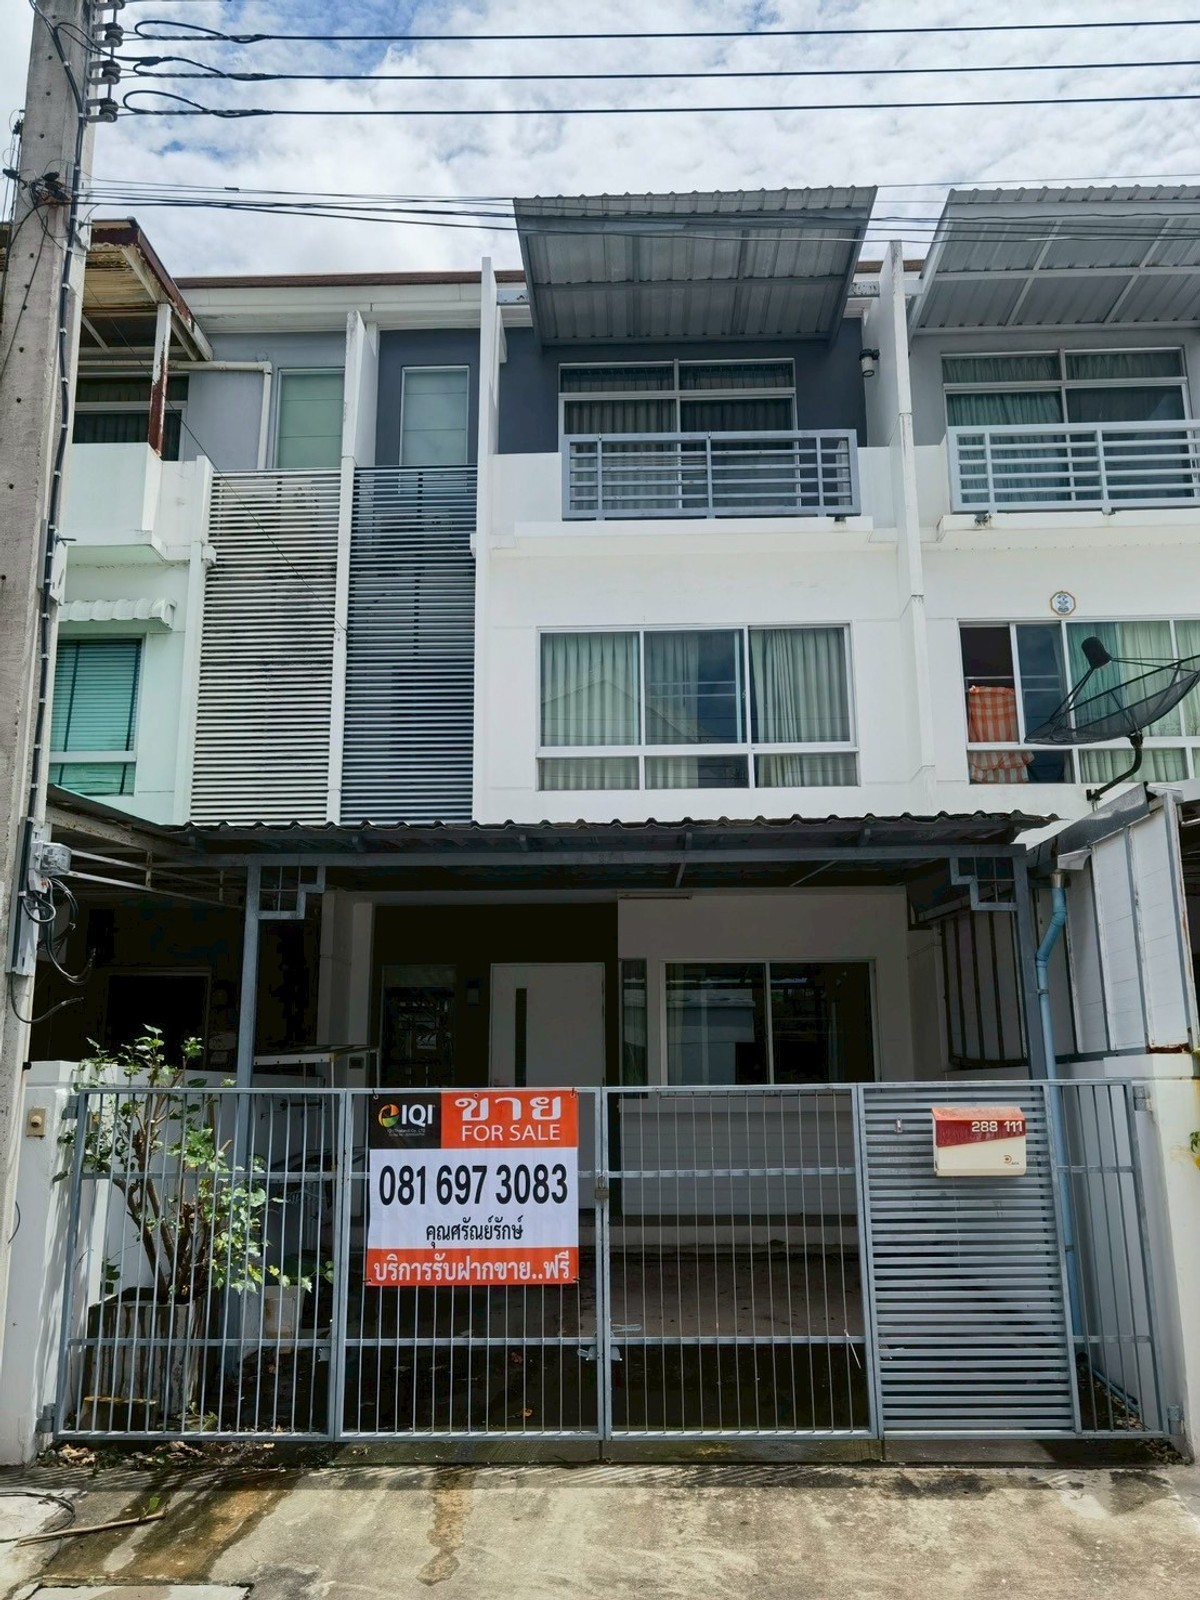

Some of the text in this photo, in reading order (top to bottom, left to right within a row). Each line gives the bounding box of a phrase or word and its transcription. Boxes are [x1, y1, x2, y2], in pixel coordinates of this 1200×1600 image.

[401, 1104, 433, 1127] IQI
[454, 1096, 562, 1121] ขาย
[461, 1124, 560, 1141] FOR SALE
[971, 1121, 1023, 1133] 288 111
[379, 1163, 568, 1206] 081 697 3083
[426, 1215, 524, 1249] คุณศรัณย์รักษ์
